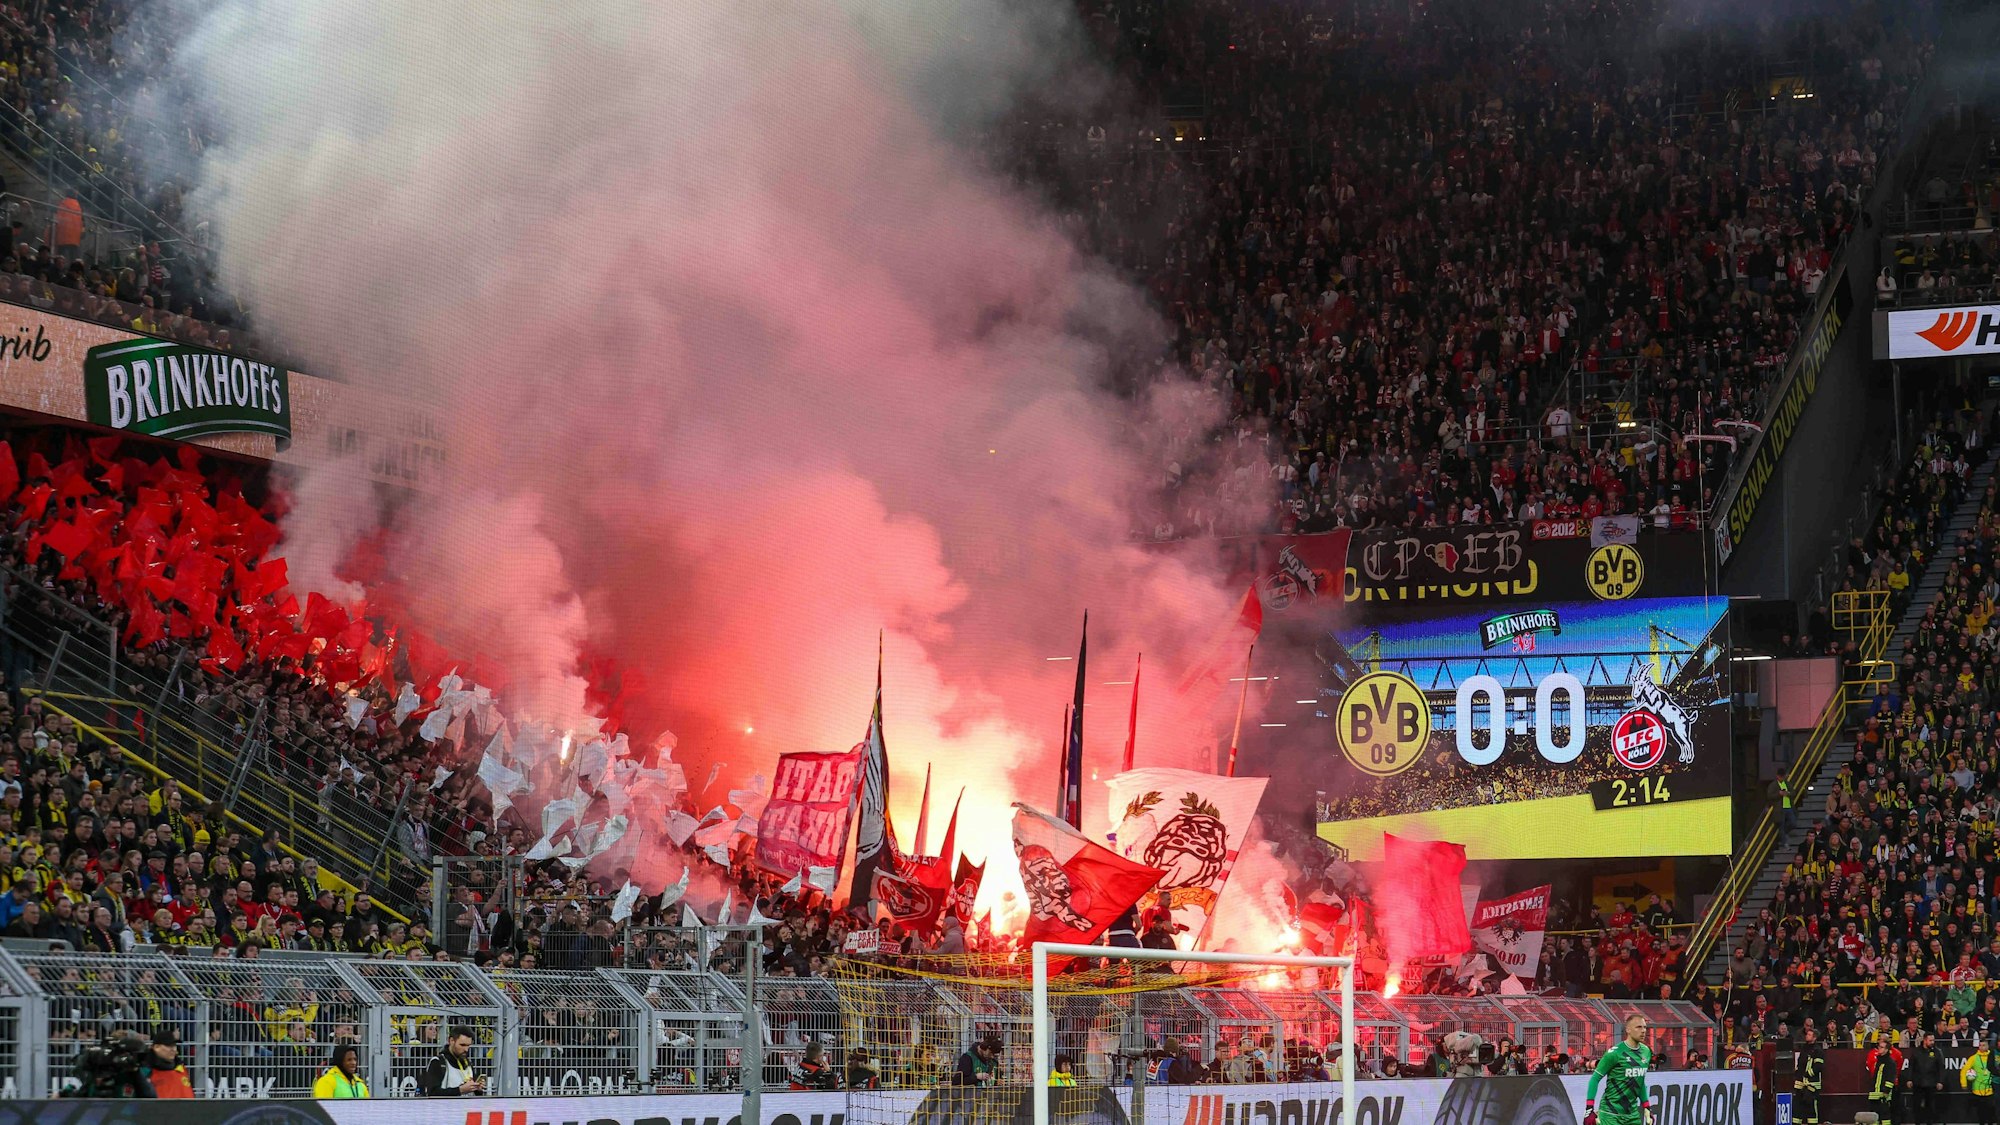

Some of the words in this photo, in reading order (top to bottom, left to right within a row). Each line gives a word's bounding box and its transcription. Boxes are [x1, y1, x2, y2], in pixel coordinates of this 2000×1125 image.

[1731, 452, 1773, 544] SIGNAL
[1770, 380, 1804, 461] IDUNA
[1813, 298, 1842, 373] PARK
[1551, 523, 1575, 536] 2012
[1595, 549, 1637, 584] BVB
[1607, 584, 1623, 596] 09
[1351, 683, 1420, 743] BVB
[1456, 674, 1586, 765] 0:0
[1371, 743, 1396, 764] 09
[1628, 746, 1650, 760] KÖLN
[1611, 775, 1671, 807] 2:14
[1777, 1103, 1790, 1124] 1&1
